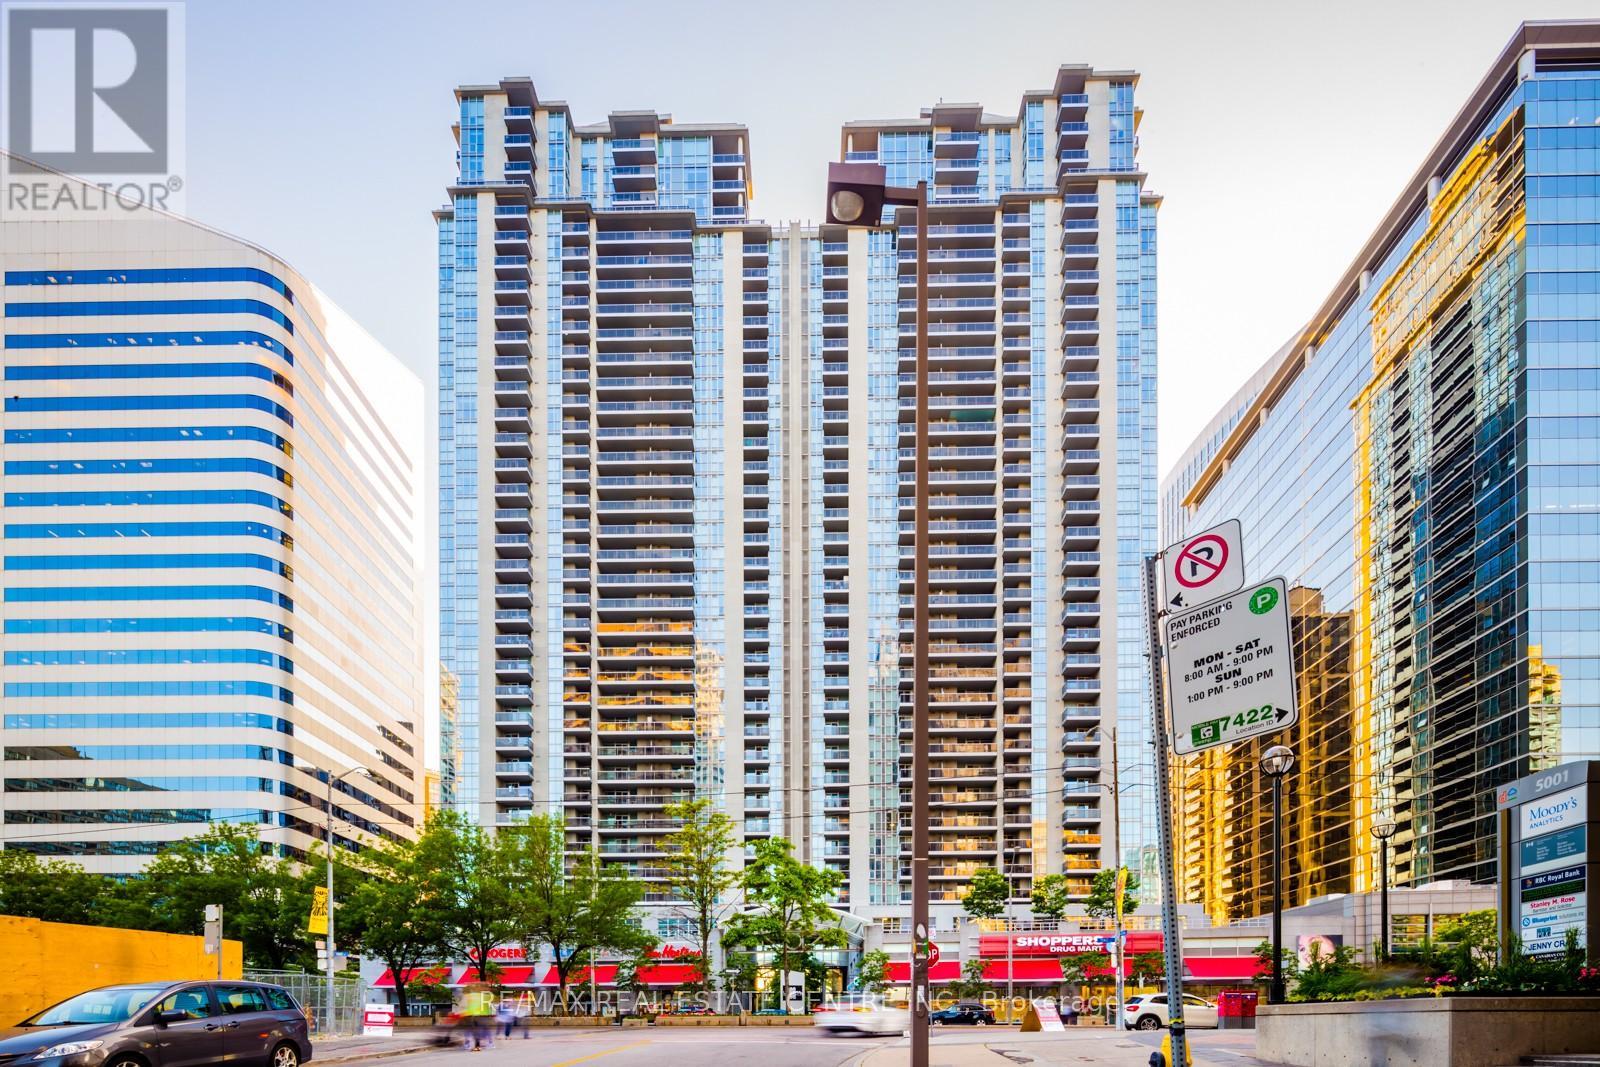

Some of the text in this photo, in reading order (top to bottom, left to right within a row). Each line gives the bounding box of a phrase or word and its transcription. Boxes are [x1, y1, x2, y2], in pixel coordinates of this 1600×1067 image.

[1170, 601, 1233, 631] PAY PARKING
[1171, 617, 1221, 642] ENFORCED
[1184, 669, 1203, 682] 8:00
[1206, 662, 1224, 675] AM
[1233, 652, 1253, 667] 9:00
[1256, 645, 1273, 659] PM
[1193, 651, 1224, 668] MON
[1235, 638, 1261, 654] SAT
[1187, 691, 1205, 703] 1:00
[1207, 685, 1224, 697] PM
[1233, 675, 1253, 689] 9:00
[1256, 668, 1273, 681] PM
[1215, 667, 1242, 683] SUN
[1220, 704, 1273, 732] 7422
[1235, 719, 1274, 735] Location ID
[1535, 769, 1569, 793] 5001
[1529, 815, 1564, 830] ANALYTICS
[1547, 872, 1564, 882] Royal
[1564, 869, 1580, 878] Bank
[1530, 901, 1551, 909] Stanley
[1560, 896, 1576, 904] Rose
[1529, 942, 1553, 951] JENNY
